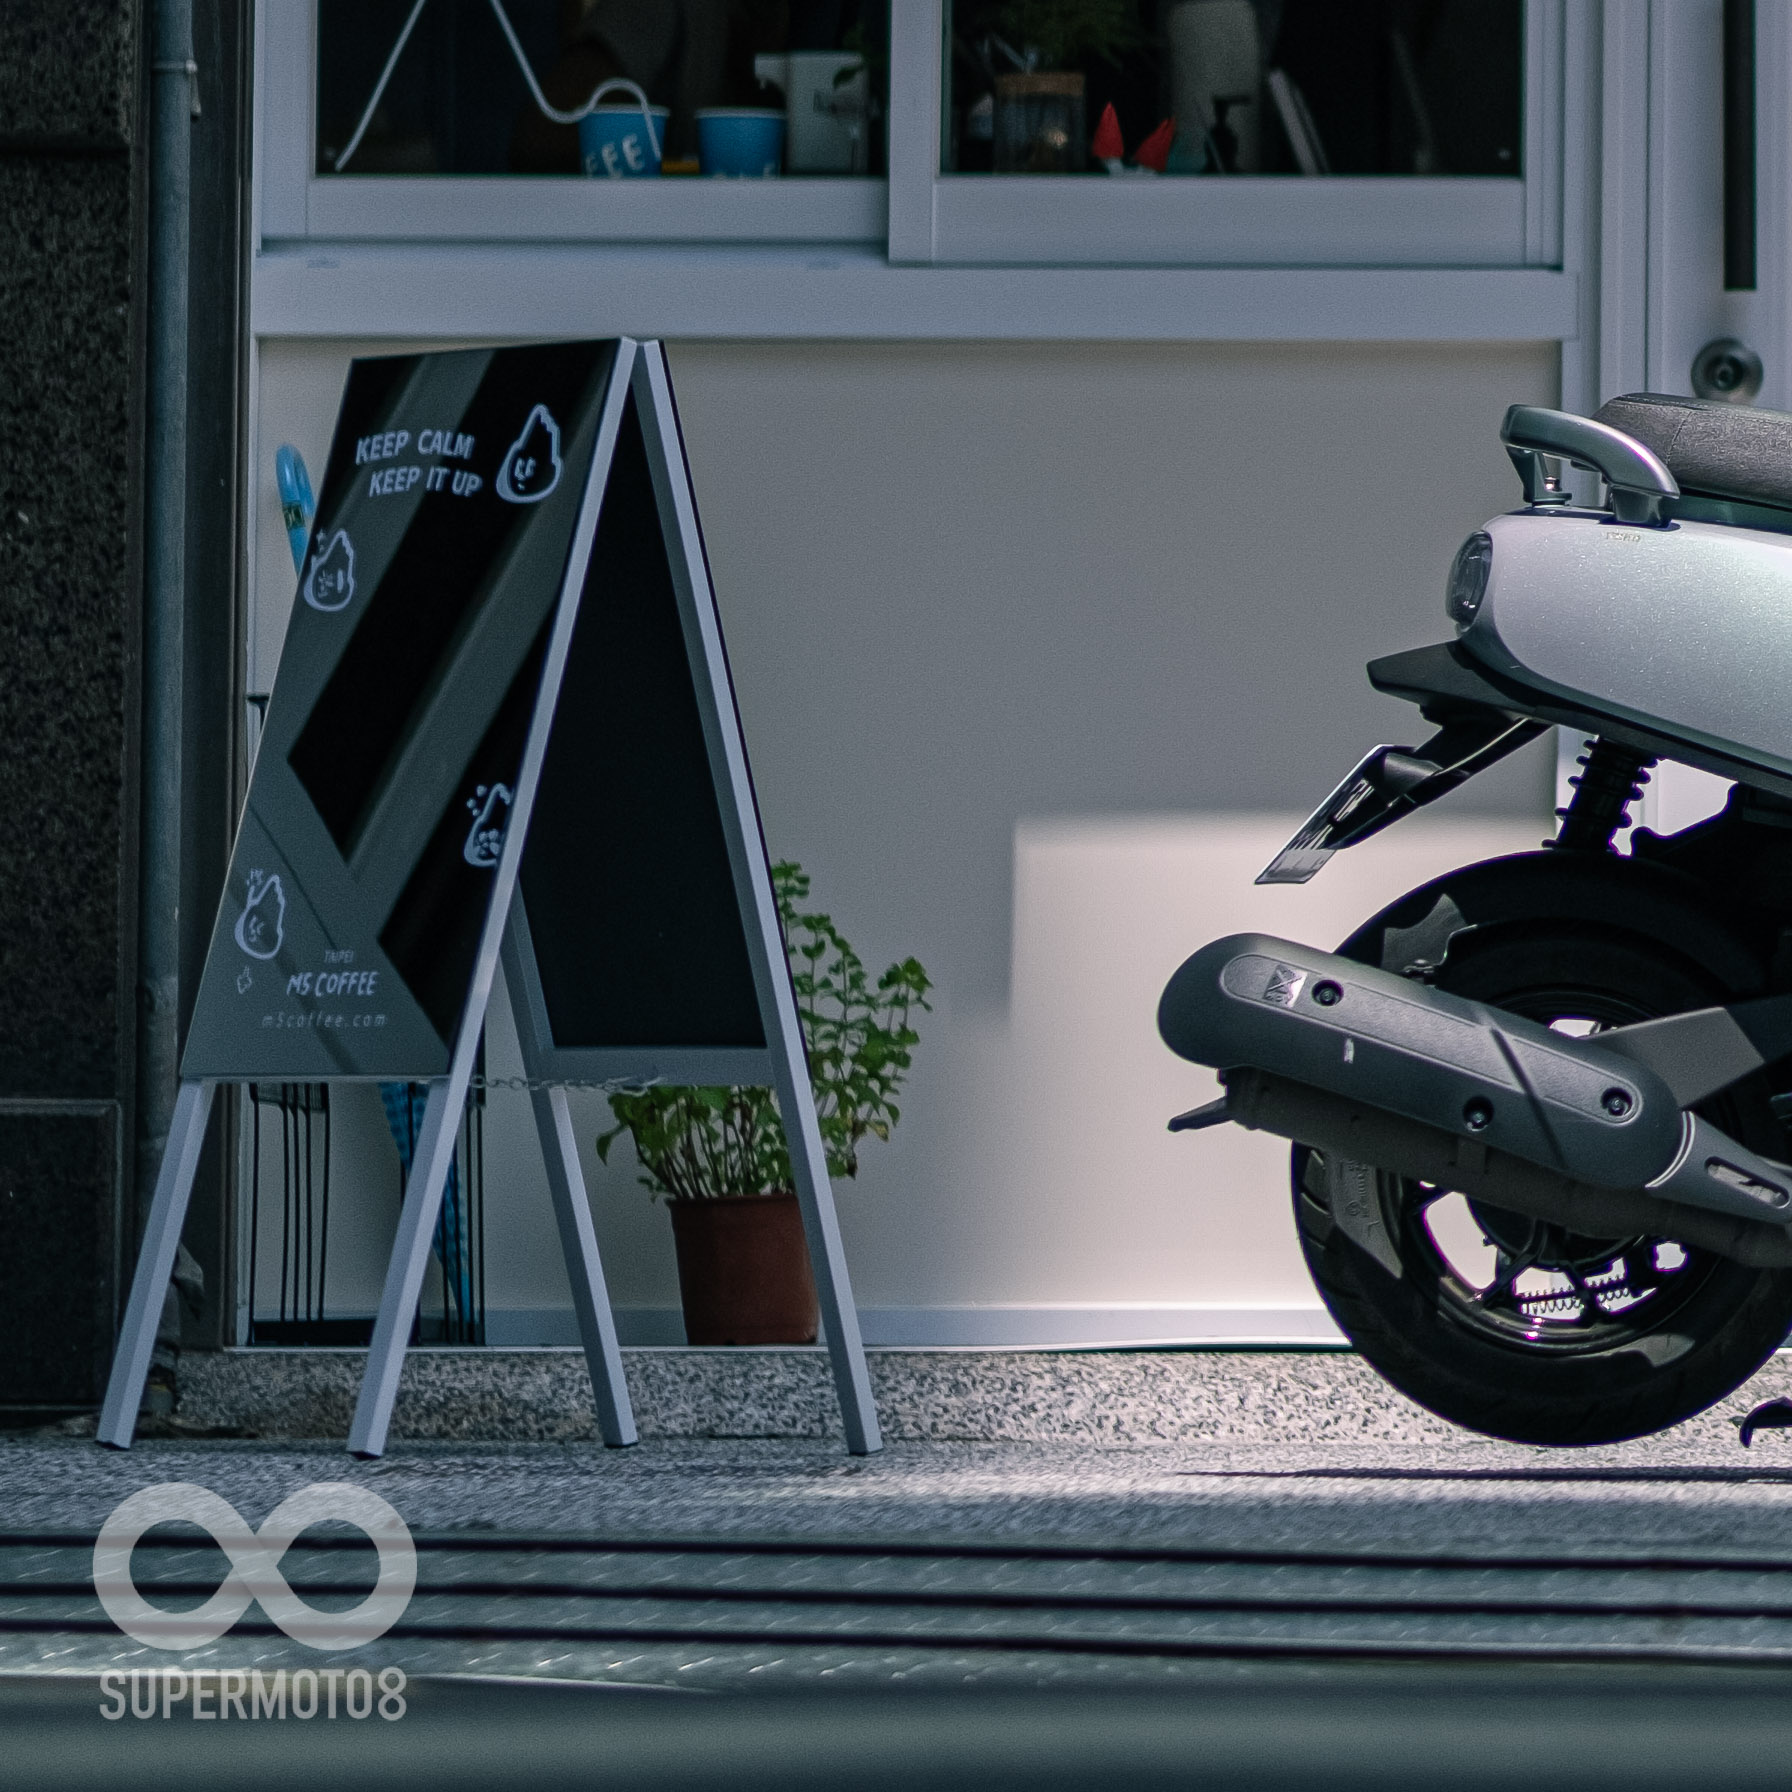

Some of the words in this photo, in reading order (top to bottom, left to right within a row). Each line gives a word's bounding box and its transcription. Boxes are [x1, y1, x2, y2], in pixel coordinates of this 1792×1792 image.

[356, 430, 410, 465] KEEP
[418, 429, 475, 460] CALM
[369, 466, 422, 497] KEEP
[426, 466, 450, 492] IT
[451, 470, 483, 498] UP
[286, 971, 313, 997] M5
[315, 971, 380, 998] COFFEE
[261, 1009, 387, 1029] m5coffee.com
